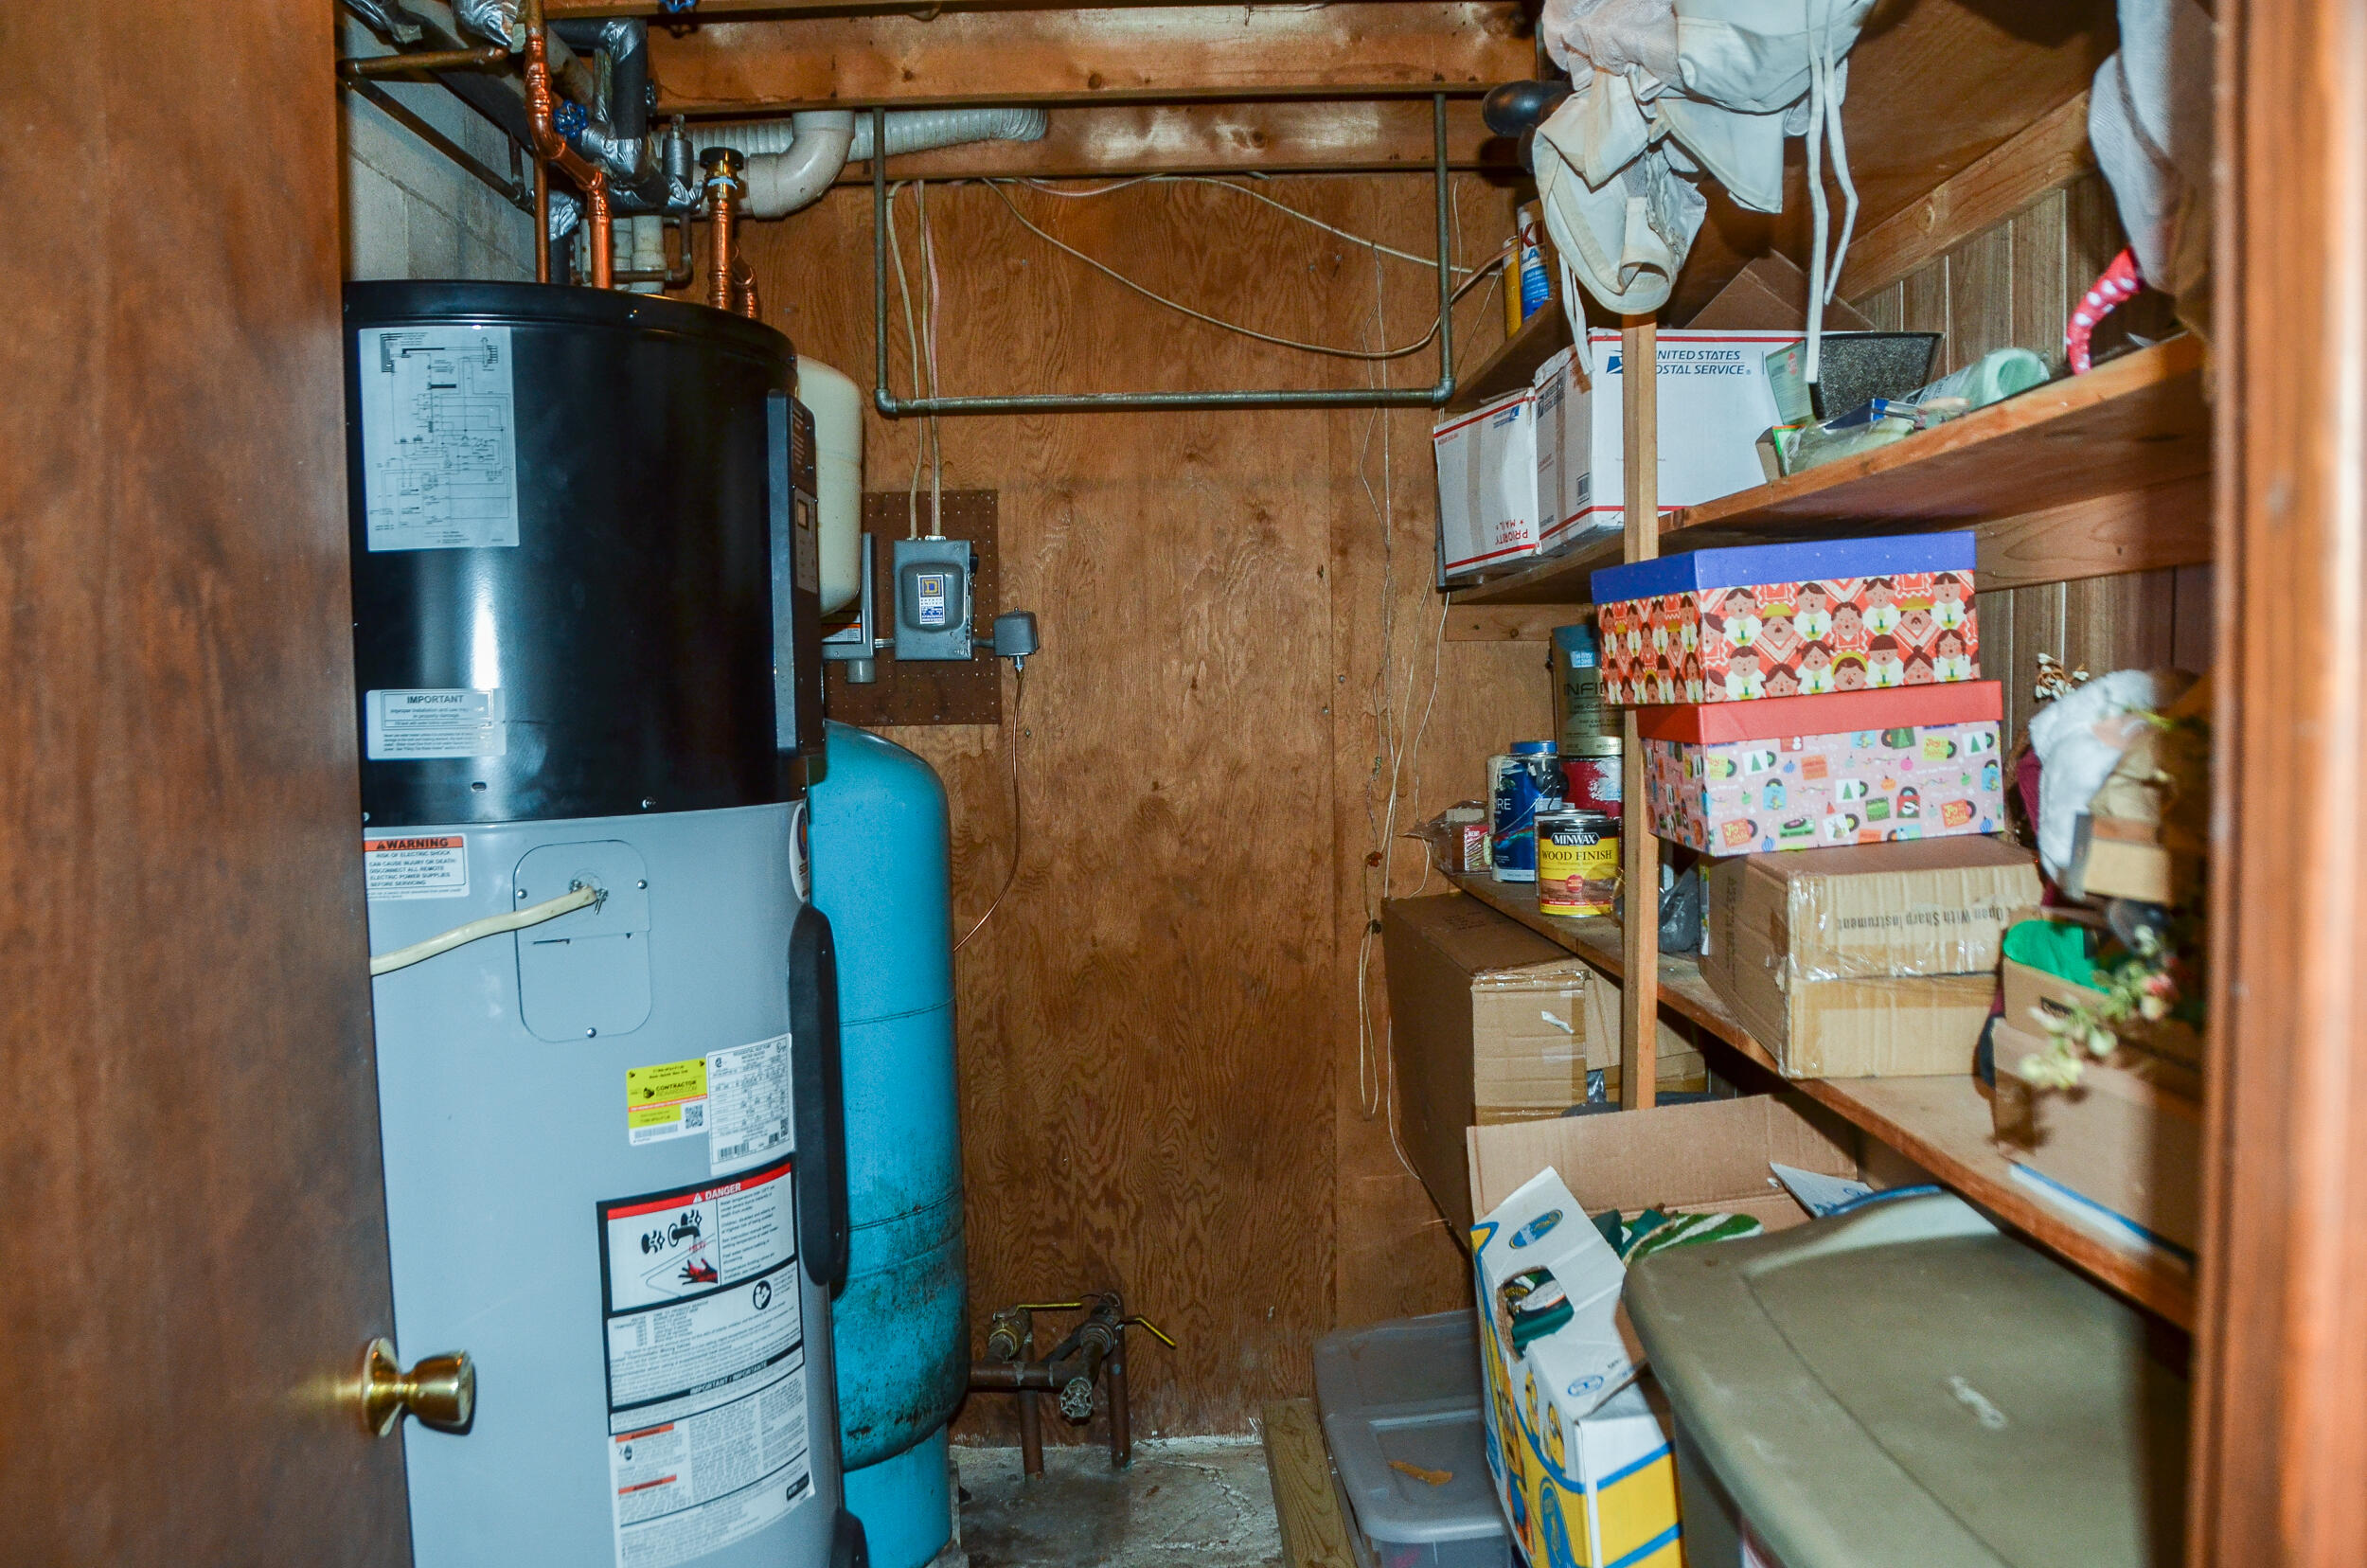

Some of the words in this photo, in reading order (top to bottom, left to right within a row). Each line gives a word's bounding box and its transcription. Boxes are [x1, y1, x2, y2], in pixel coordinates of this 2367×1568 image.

[1657, 350, 1696, 360] NITED
[1698, 350, 1740, 360] STATES
[1656, 365, 1692, 375] OSTAL
[1695, 365, 1745, 375] SERVICE
[1495, 528, 1528, 545] PRIORITY
[1563, 682, 1605, 696] INFI
[407, 694, 464, 704] IMPORTANT
[1497, 798, 1512, 811] RE
[386, 838, 449, 849] WARNING
[1554, 834, 1596, 845] MINWAX
[1542, 850, 1573, 861] WOOD
[1575, 849, 1612, 861] FINISH
[1905, 911, 1940, 927] Sharp
[1943, 909, 1970, 924] With
[1837, 914, 1903, 933] Instrument
[704, 1182, 742, 1202] DANGER
